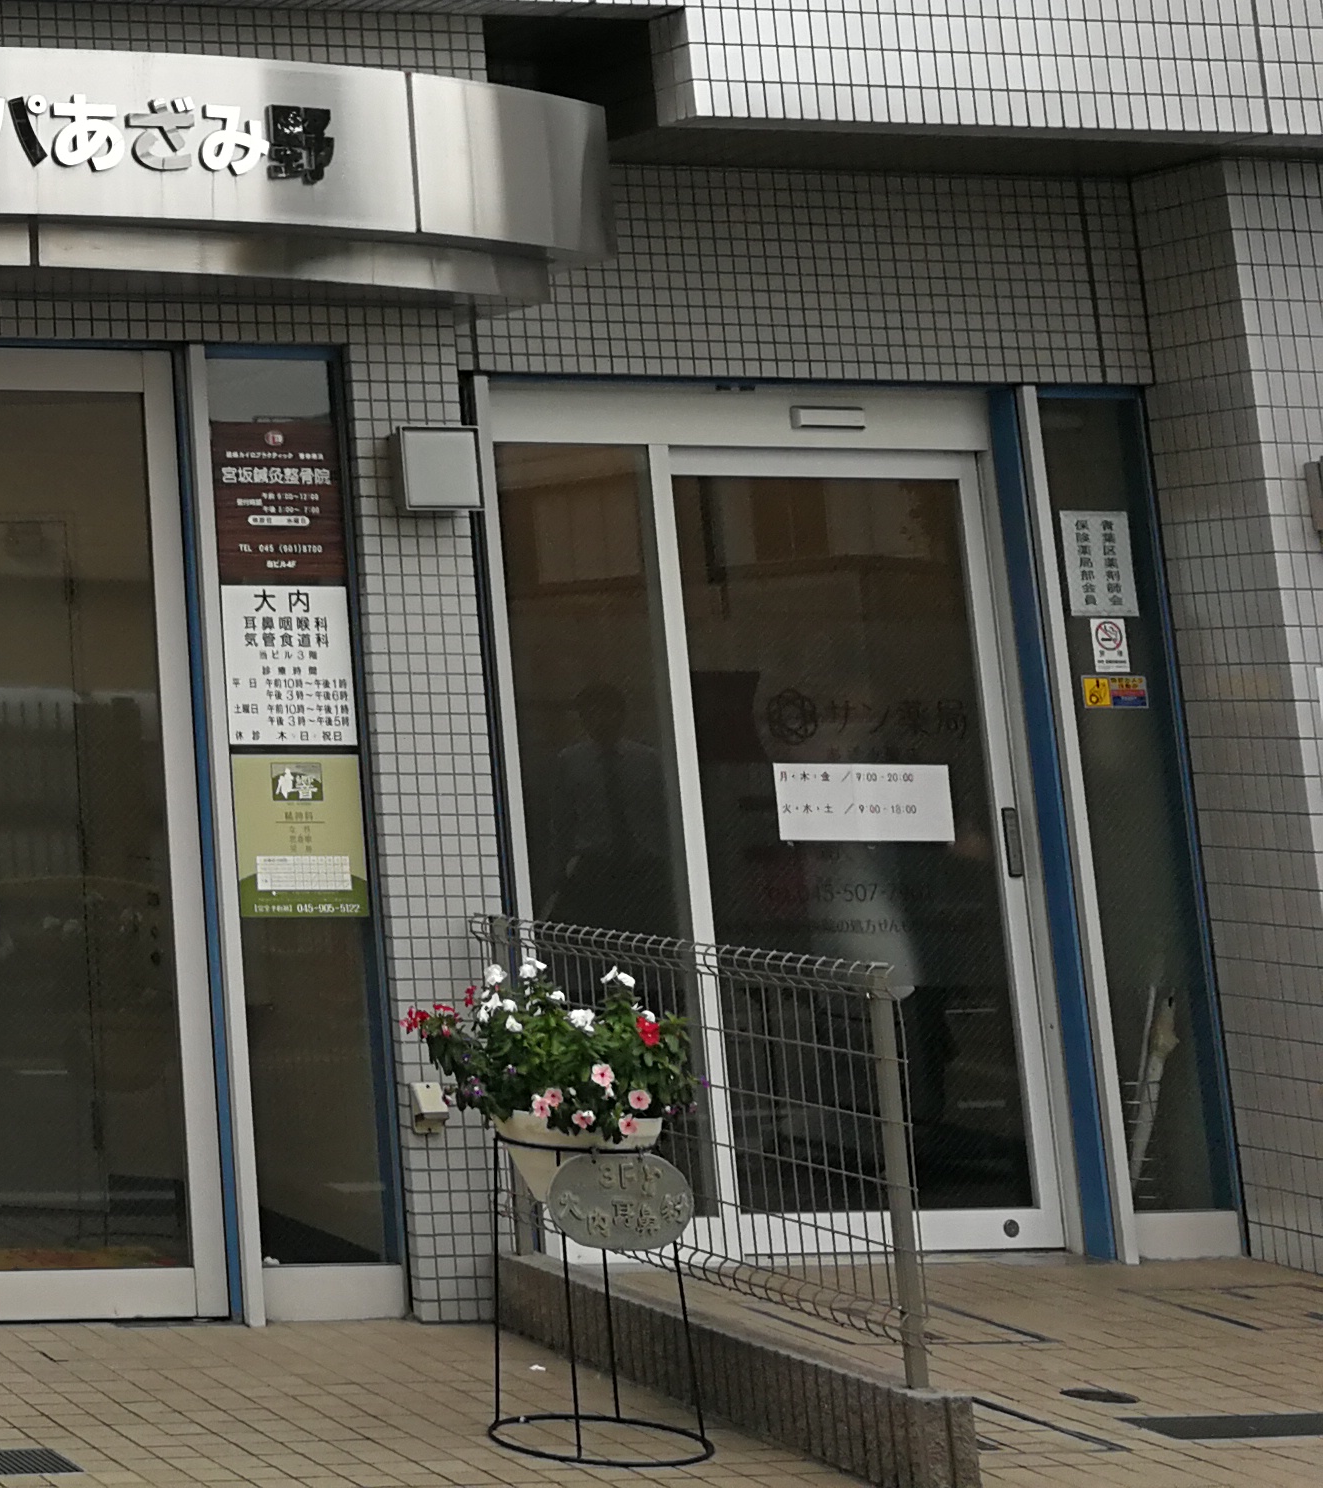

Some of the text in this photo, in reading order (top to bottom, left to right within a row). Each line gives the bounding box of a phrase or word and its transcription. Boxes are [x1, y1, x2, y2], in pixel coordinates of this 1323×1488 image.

[221, 466, 332, 485] 宮坂鍼灸整骨院
[238, 543, 252, 553] TEL
[253, 589, 311, 613] 大内
[243, 615, 328, 632] 耳鼻咽喉科
[244, 632, 330, 648] 気管食道科
